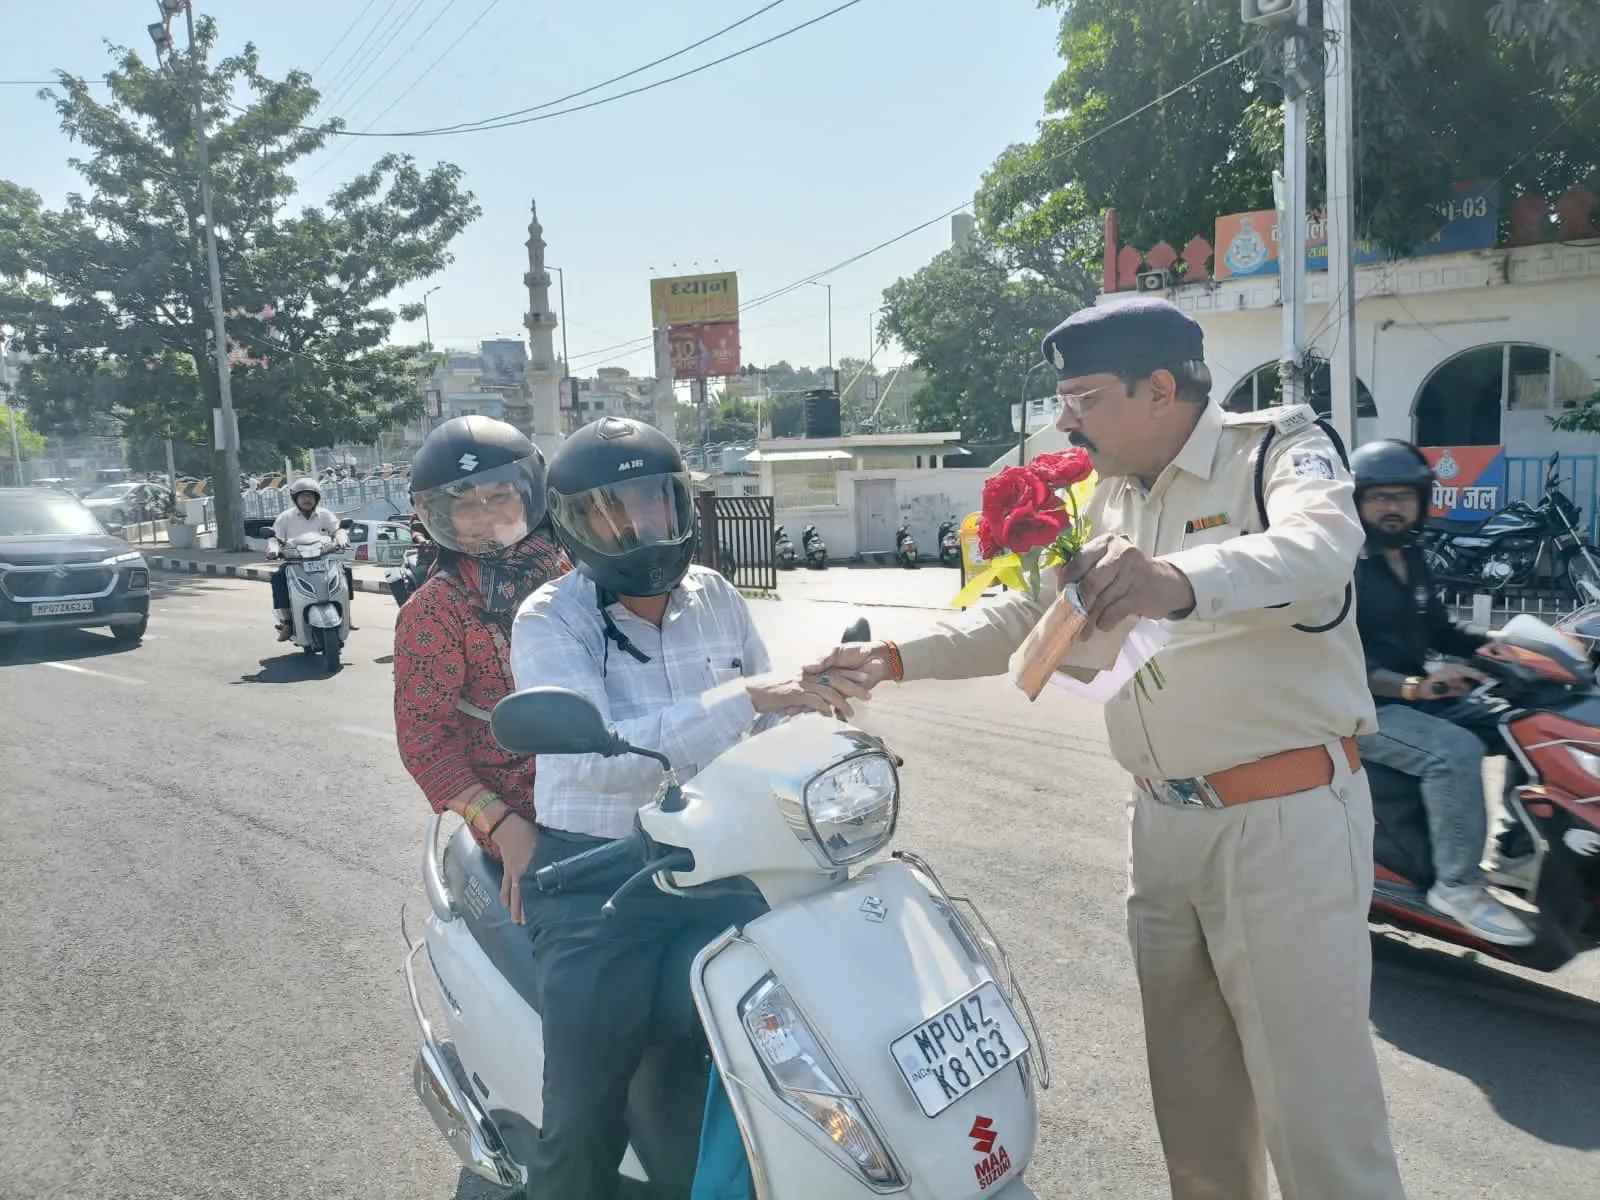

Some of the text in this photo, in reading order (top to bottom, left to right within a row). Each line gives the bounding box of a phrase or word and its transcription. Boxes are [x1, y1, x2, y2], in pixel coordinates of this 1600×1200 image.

[1463, 487, 1499, 510] जल
[913, 994, 993, 1064] MP04Z
[932, 1028, 1011, 1099] K8163
[974, 1145, 1008, 1180] MAA
[978, 1157, 1011, 1190] SUZUKI
